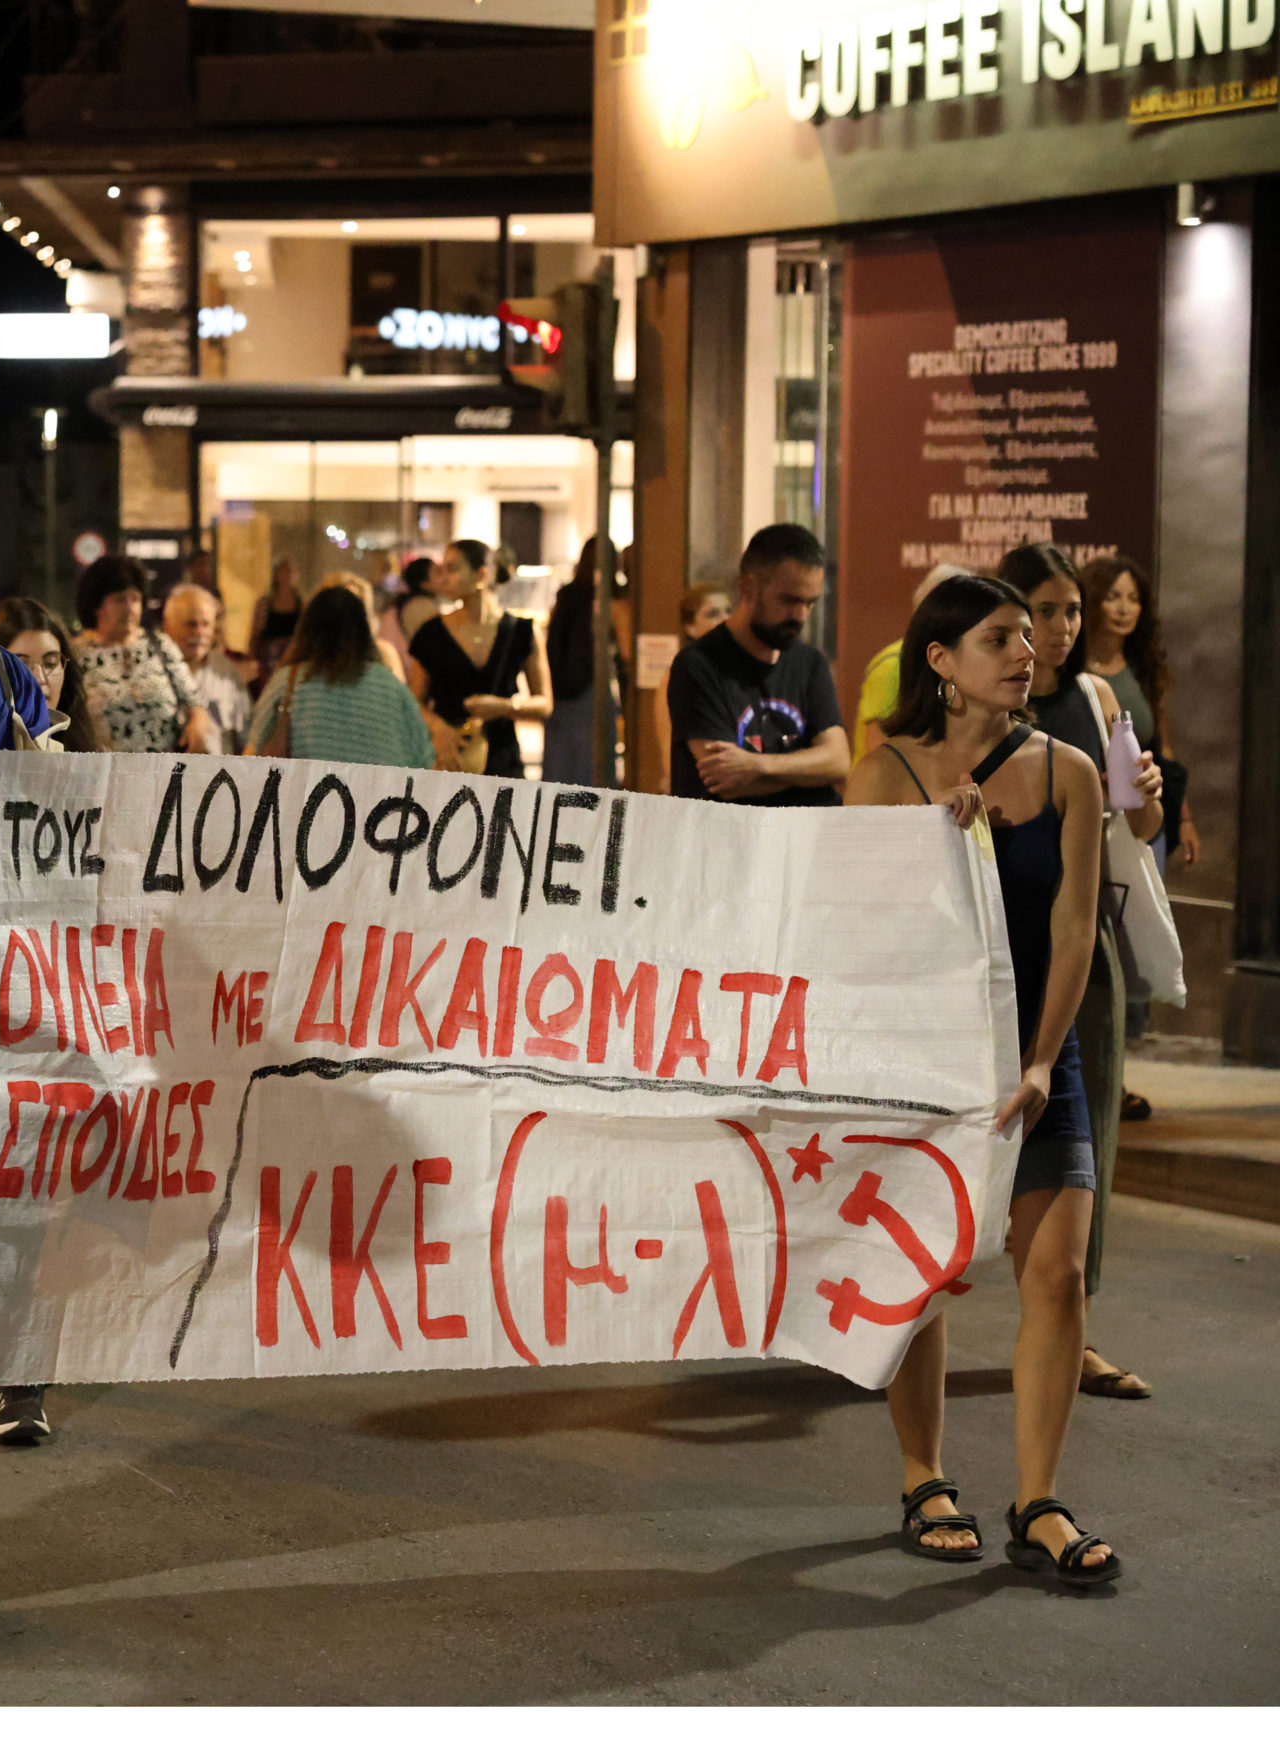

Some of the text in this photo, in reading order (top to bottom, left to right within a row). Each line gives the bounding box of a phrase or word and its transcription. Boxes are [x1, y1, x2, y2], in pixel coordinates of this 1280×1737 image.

[786, 0, 1274, 122] COFFEE ISLAND
[985, 347, 1037, 374] COFFEE
[1039, 344, 1080, 371] SINCE
[3, 800, 106, 881] ΤΟΥΣ
[211, 970, 270, 1049] ΜΕ
[293, 921, 810, 1087] ΔΙΚΑΙΩΜΑΤΑ
